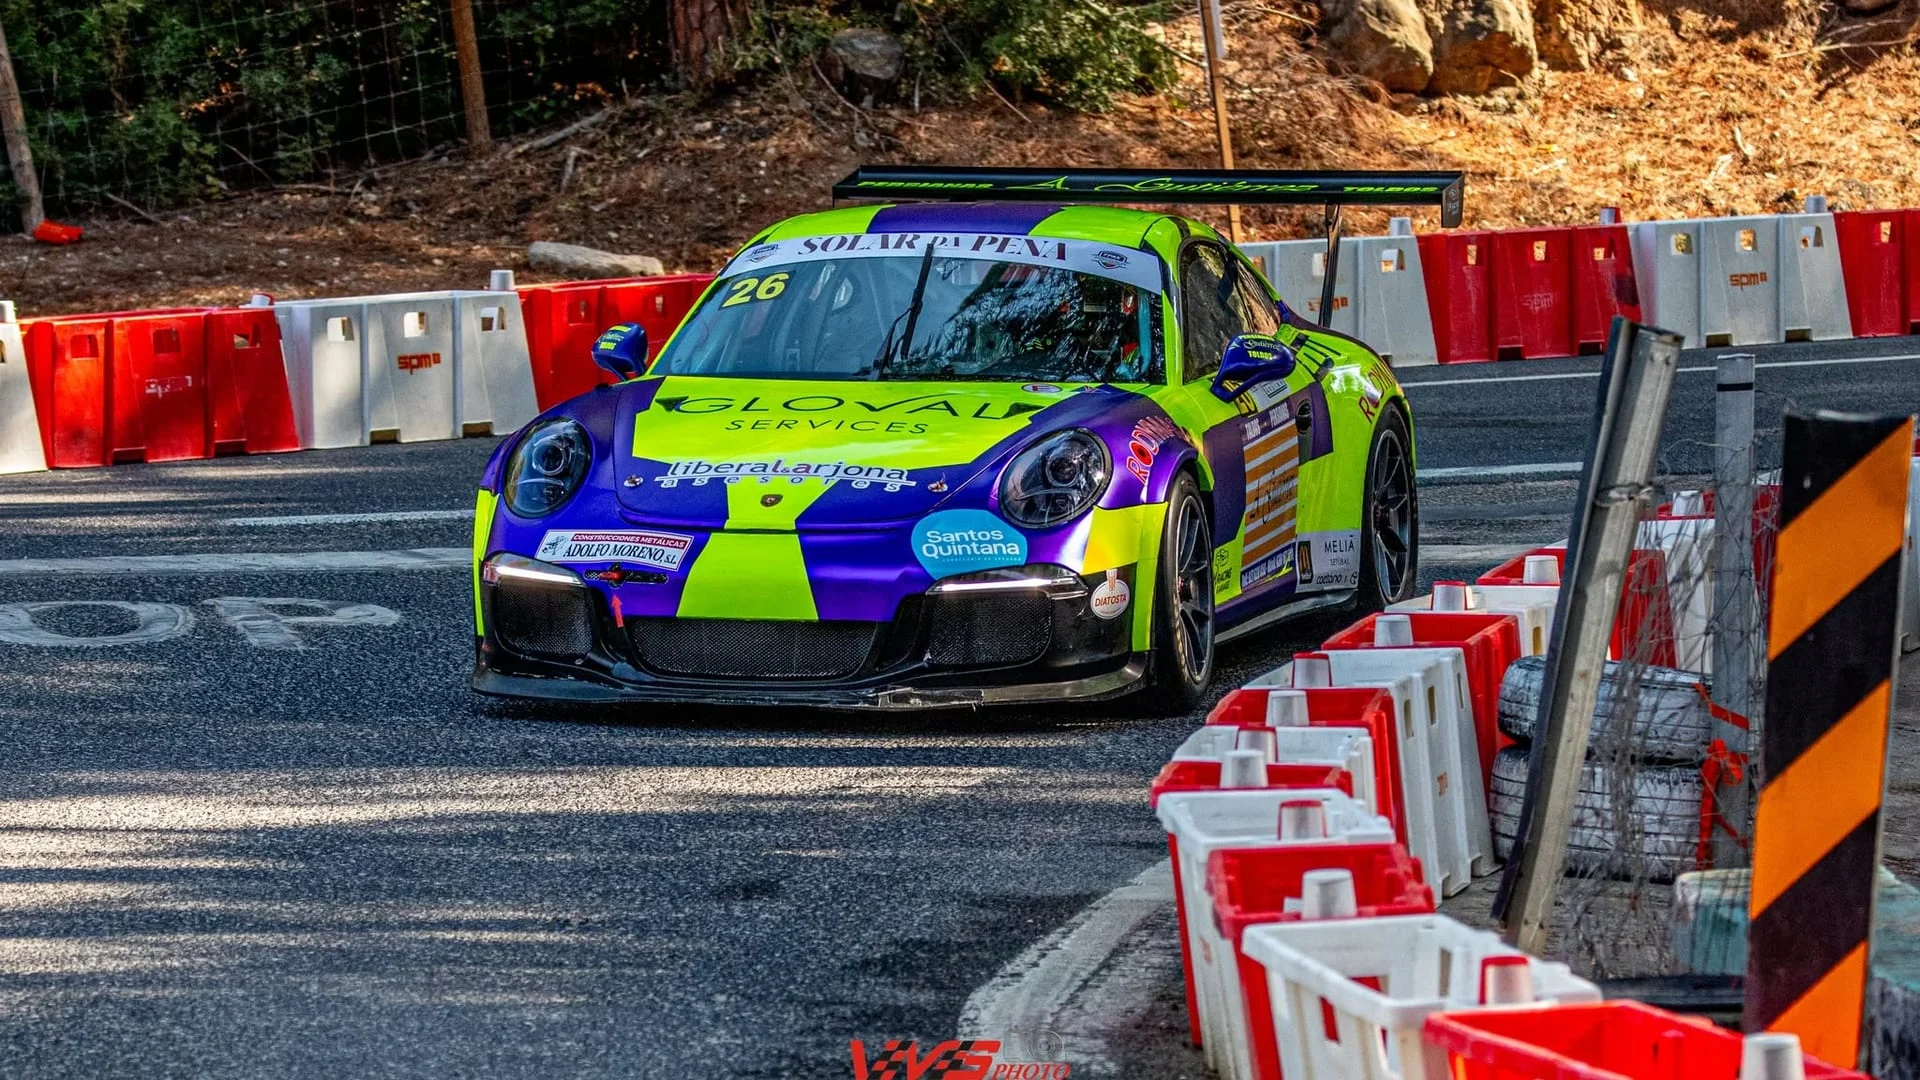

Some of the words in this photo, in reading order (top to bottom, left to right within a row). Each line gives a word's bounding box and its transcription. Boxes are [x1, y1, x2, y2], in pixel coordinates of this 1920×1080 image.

[797, 233, 921, 256] SOLAR
[929, 235, 960, 249] DA
[969, 235, 1067, 262] PENA
[721, 273, 790, 309] 26
[674, 393, 1005, 420] GLOVAL
[725, 419, 929, 434] SERVICES
[663, 475, 902, 492] asesores
[573, 534, 641, 544] CONSTRUCCIONES
[641, 536, 685, 549] METÁLICAS
[926, 530, 1004, 543] Santos
[563, 543, 611, 558] ADOLFO
[610, 544, 663, 563] MORENO,
[922, 541, 1020, 559] Quintana
[1095, 593, 1127, 607] DIATOSTA
